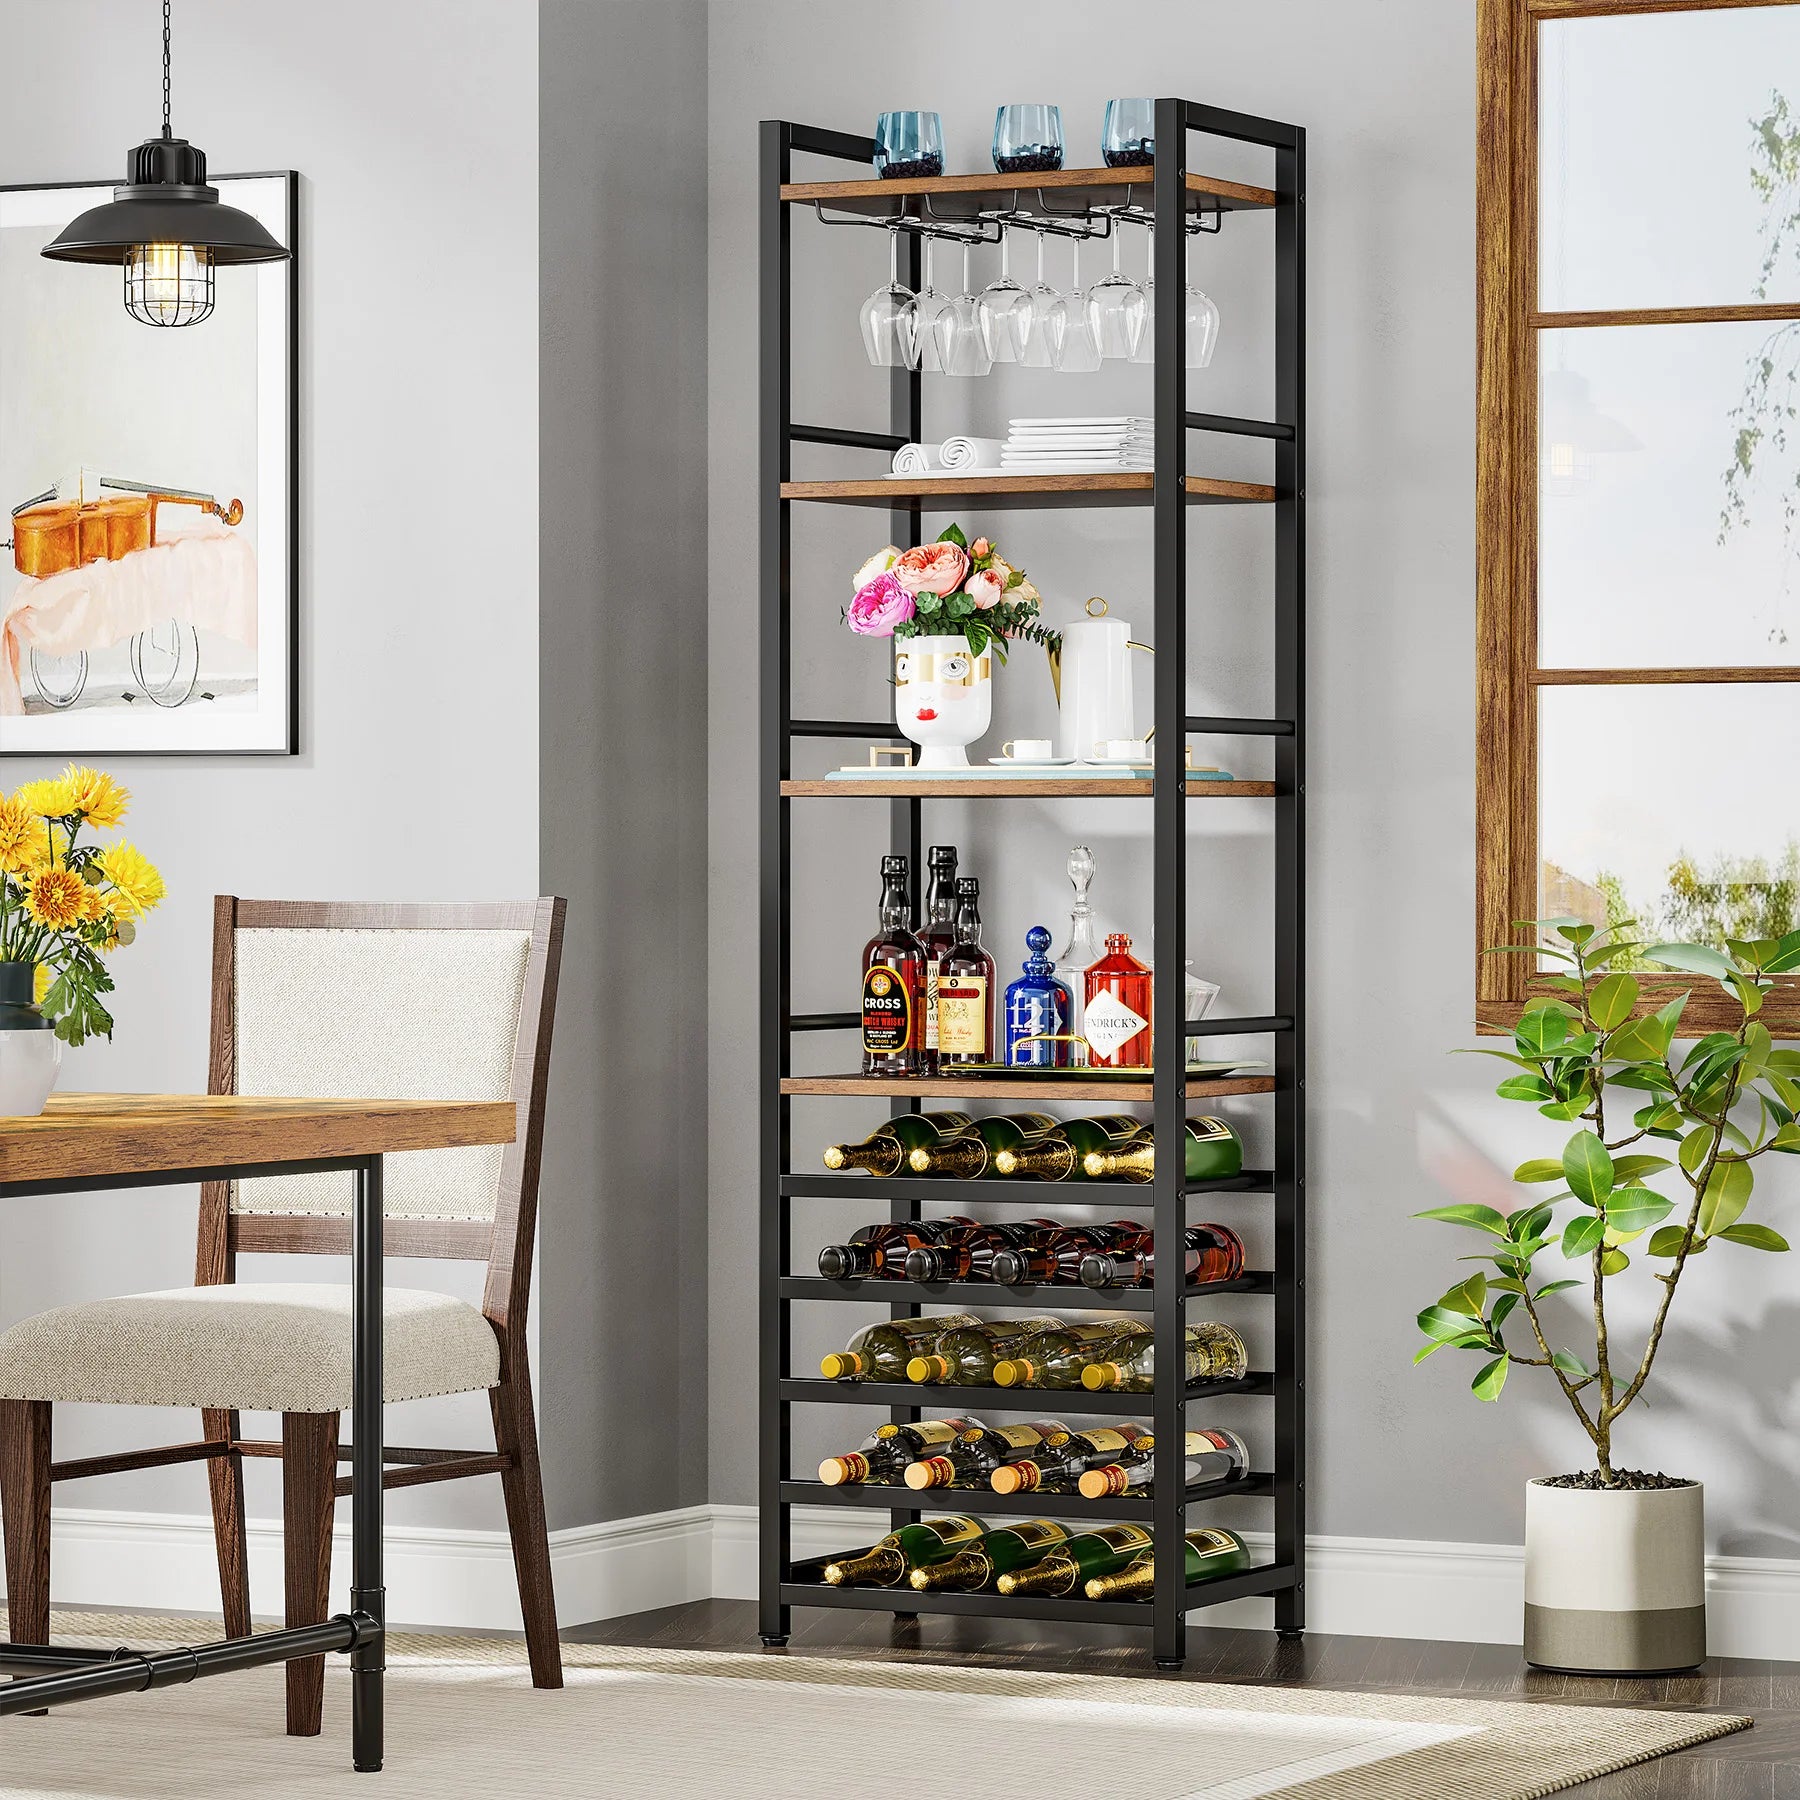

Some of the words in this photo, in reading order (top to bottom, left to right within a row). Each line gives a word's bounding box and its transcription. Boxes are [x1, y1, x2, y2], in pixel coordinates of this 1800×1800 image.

[864, 997, 901, 1009] CROSS
[1010, 1001, 1045, 1028] 12
[881, 1017, 906, 1027] WHISKY
